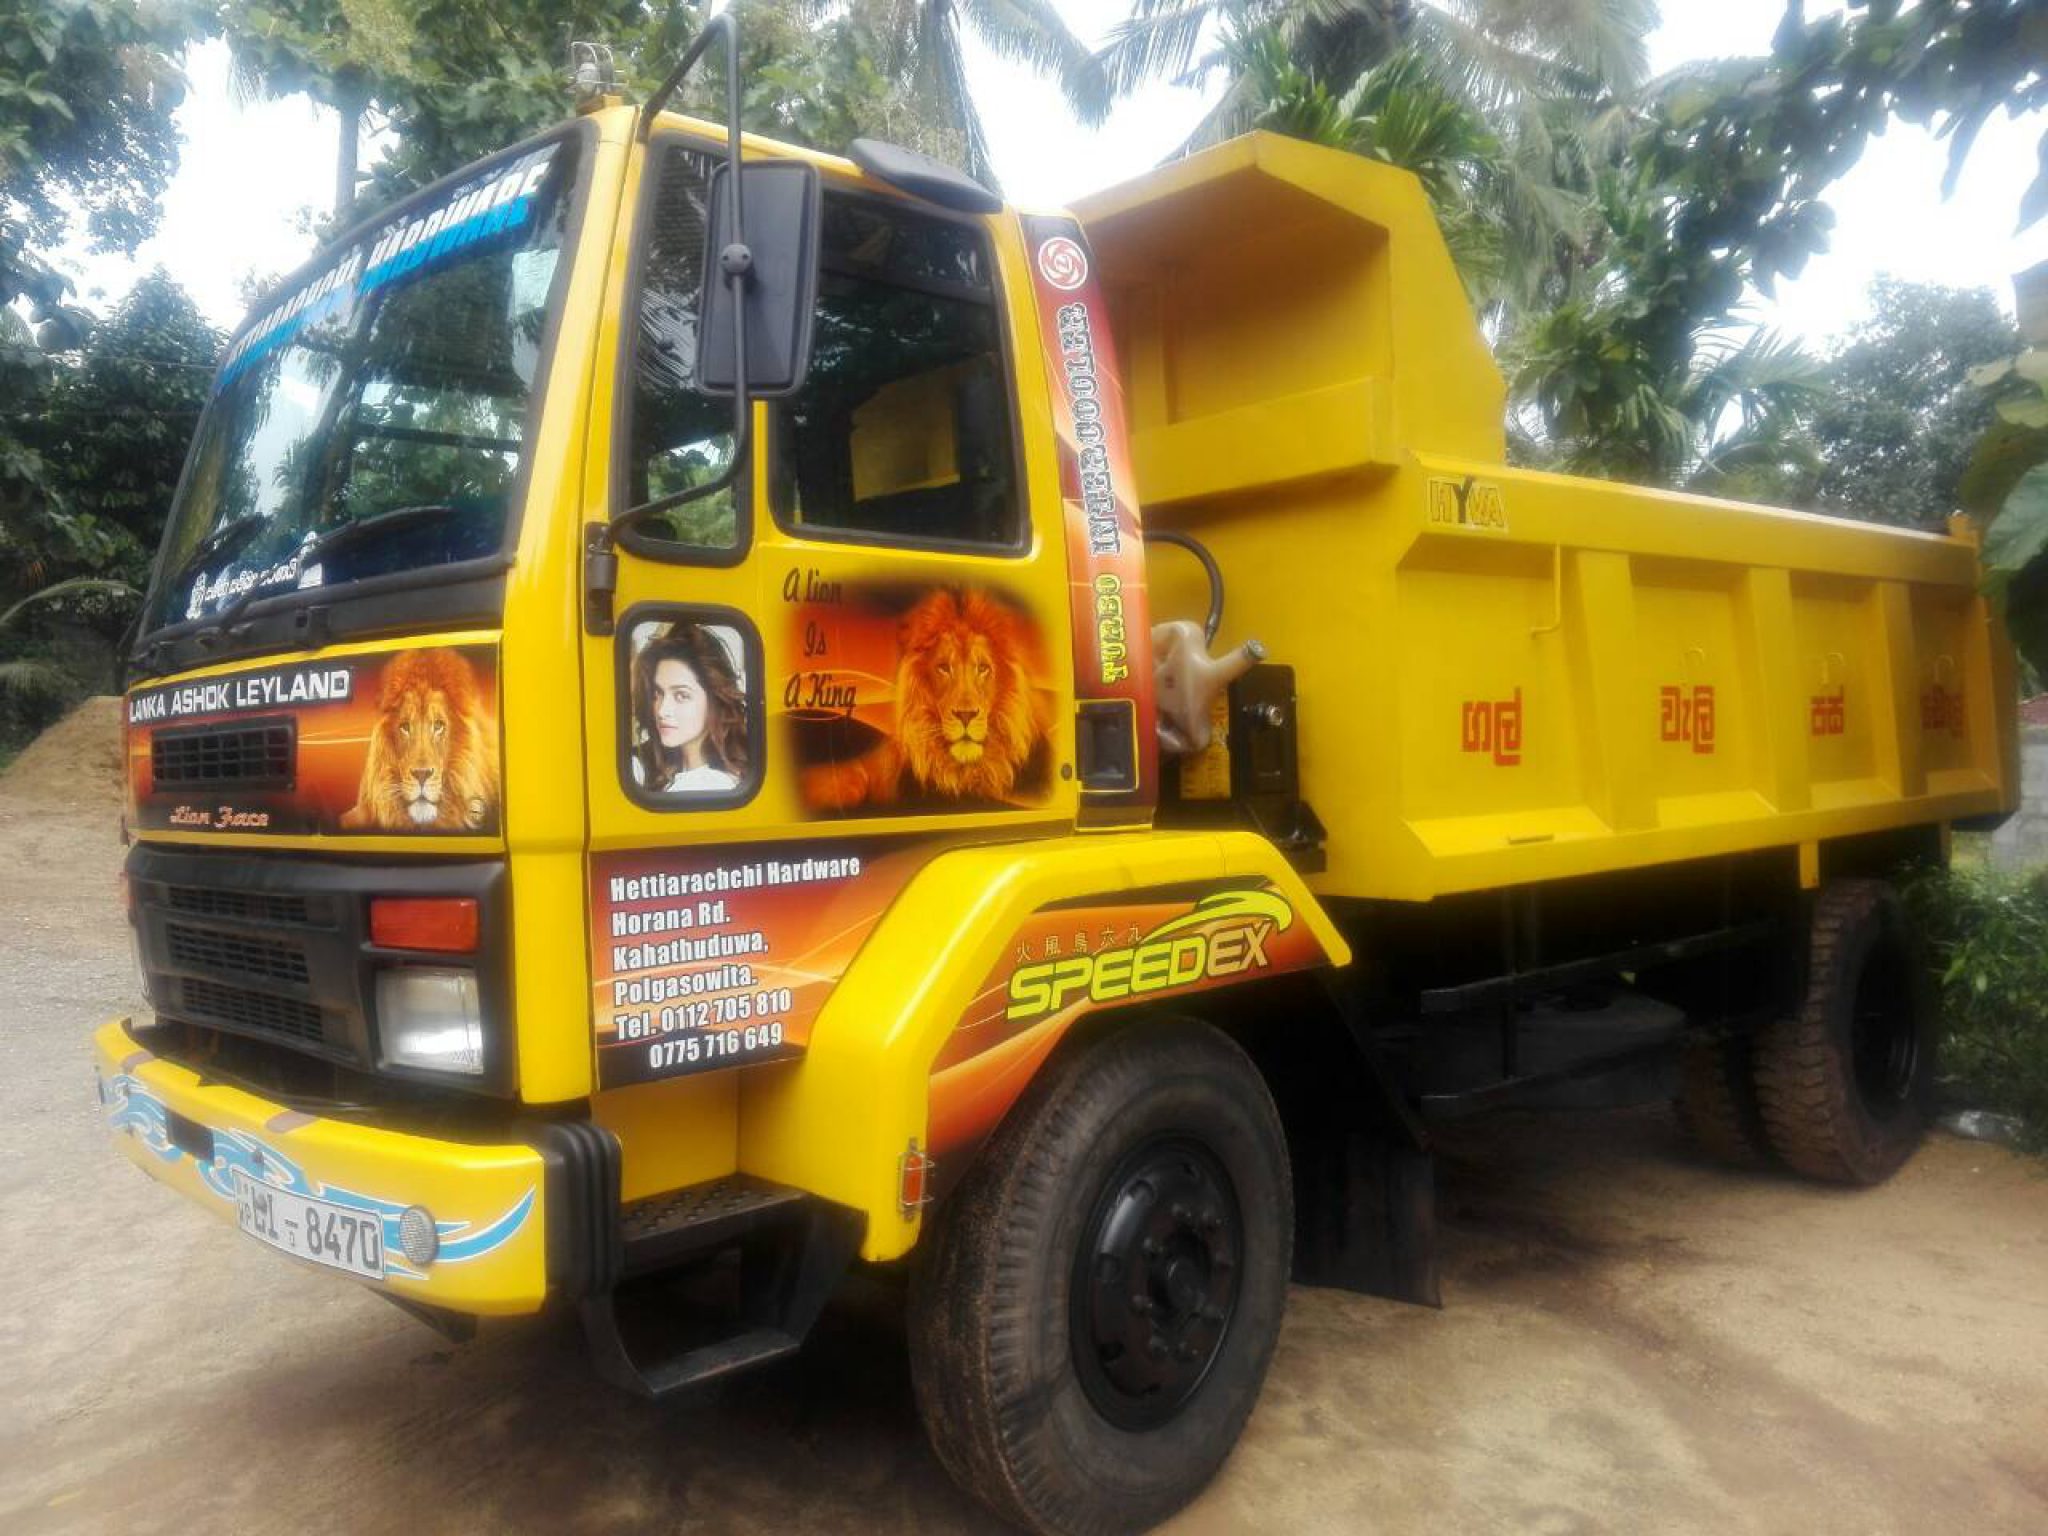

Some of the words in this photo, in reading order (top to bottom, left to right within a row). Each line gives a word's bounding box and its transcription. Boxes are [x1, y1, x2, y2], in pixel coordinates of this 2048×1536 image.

[1057, 303, 1120, 556] INTERCOOLER
[1427, 474, 1507, 531] HYVA
[1093, 572, 1129, 686] TURBO
[129, 693, 166, 723] LANKA
[170, 682, 230, 716] ASHOK
[236, 670, 350, 707] LEYLAND
[610, 863, 763, 901] Hettiarachchi
[767, 857, 861, 884] Hardware
[612, 911, 693, 936] Horana
[698, 900, 731, 926] Rd.
[1007, 922, 1272, 1020] SPEEDEX
[615, 1014, 657, 1041] Tel.
[661, 1002, 709, 1032] 0112
[714, 993, 752, 1023] 705
[755, 987, 793, 1015] 810
[649, 1039, 700, 1069] 0775
[705, 1031, 740, 1057] 716
[744, 1022, 783, 1050] 649
[305, 1206, 380, 1271] 8470
